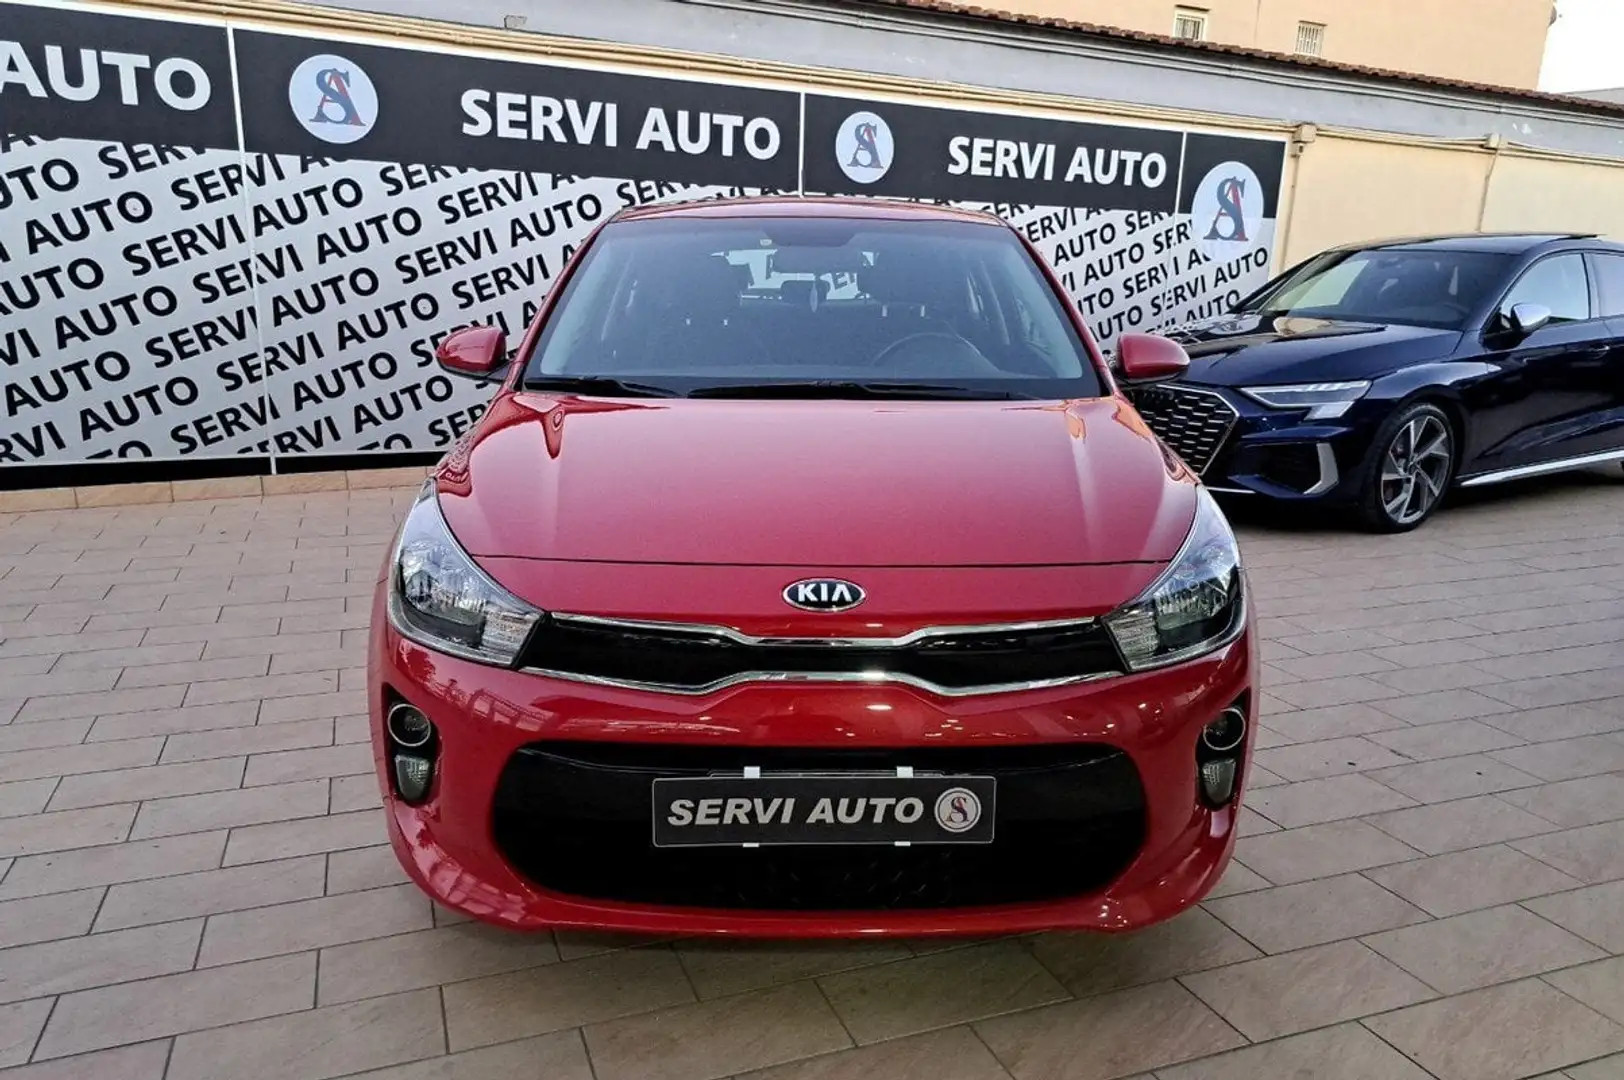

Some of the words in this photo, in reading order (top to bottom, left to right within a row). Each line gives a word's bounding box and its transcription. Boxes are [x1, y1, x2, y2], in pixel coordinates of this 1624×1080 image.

[0, 40, 211, 111] AUTO
[460, 89, 617, 147] SERVI
[636, 108, 780, 160] AUTO
[947, 136, 1055, 180] SERVI
[1064, 146, 1167, 188] AUTO
[25, 191, 153, 255] AUTO
[170, 153, 287, 211] SERVI
[0, 257, 104, 316] UTO
[122, 214, 246, 277] SERVI
[252, 178, 363, 238] AUTO
[55, 285, 178, 350] AUTO
[192, 243, 304, 304] SERVI
[316, 207, 422, 265] AUTO
[437, 172, 539, 225] SERVI
[1054, 223, 1116, 267] AUTO
[1083, 242, 1145, 289] AUTO
[1122, 256, 1181, 300] SERVI
[5, 350, 130, 417] AUTO
[145, 305, 258, 369] SERVI
[271, 267, 379, 327] AUTO
[394, 227, 498, 285] SERVI
[509, 193, 603, 248] AUTO
[1151, 275, 1207, 316] SERVI
[1213, 247, 1269, 289] AUTO
[1185, 288, 1241, 324] AUTO
[79, 376, 199, 442] AUTO
[216, 331, 325, 392] SERVI
[337, 292, 439, 351] AUTO
[451, 254, 551, 310] SERVI
[170, 393, 280, 455] SERVI
[293, 351, 398, 412] AUTO
[353, 375, 454, 434] AUTO
[797, 583, 853, 602] KIA
[667, 797, 796, 826] SERVI
[806, 797, 925, 824] AUTO
